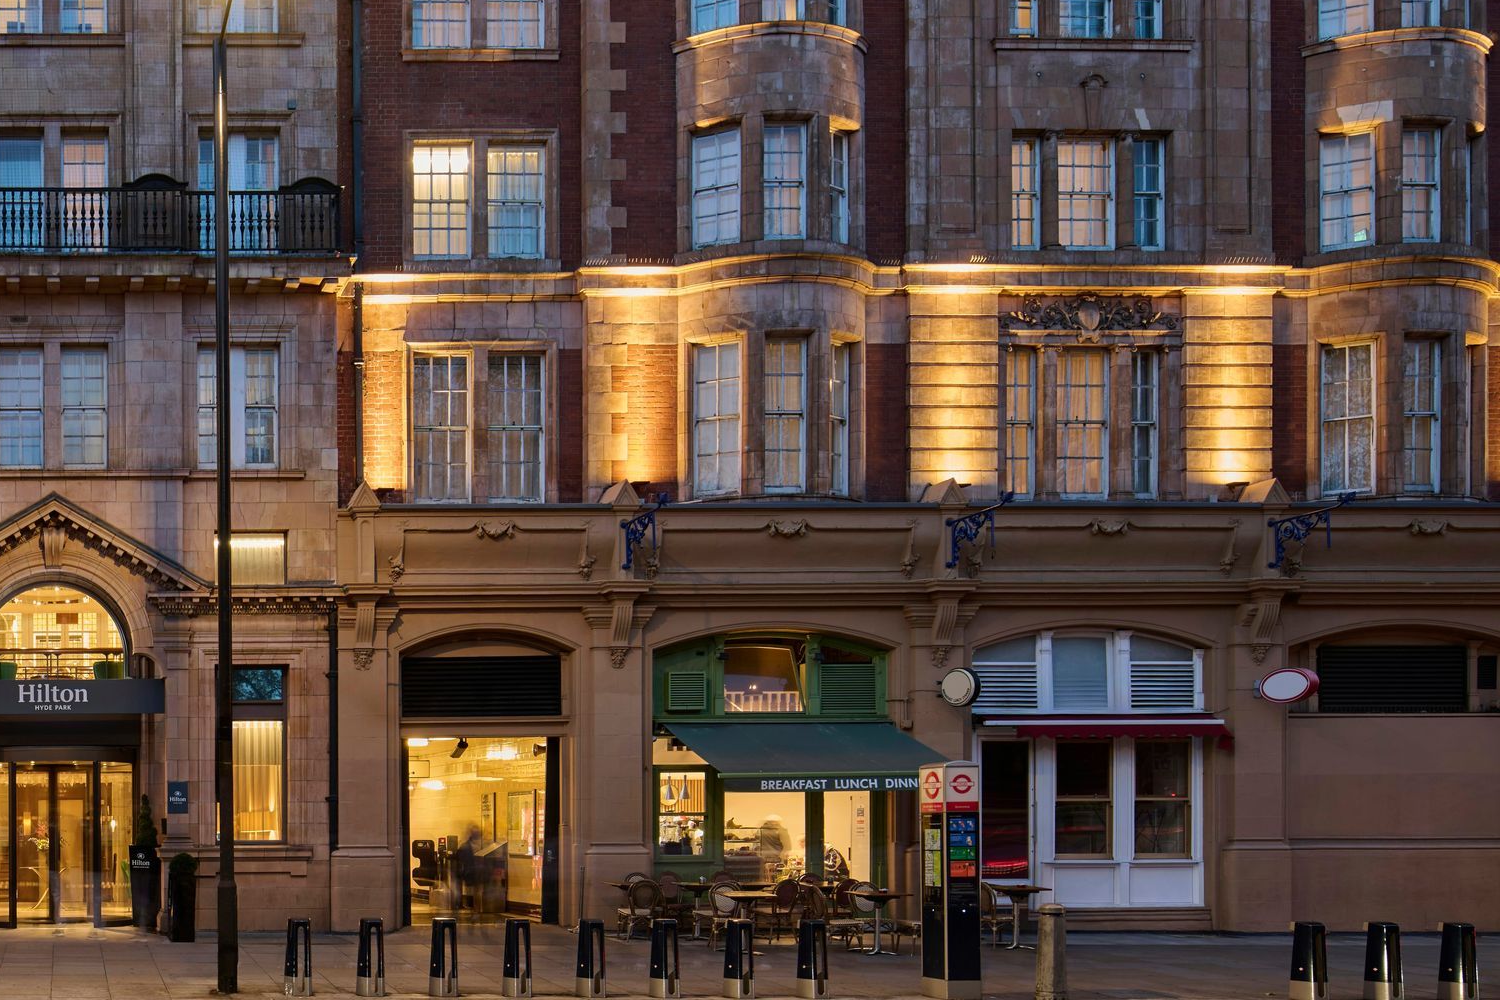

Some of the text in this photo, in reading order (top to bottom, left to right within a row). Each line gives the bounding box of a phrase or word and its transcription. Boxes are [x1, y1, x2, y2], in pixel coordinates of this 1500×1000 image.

[17, 683, 89, 703] Hilton
[760, 779, 828, 791] BREAKFAST
[834, 778, 878, 790] LUNCH
[885, 778, 919, 789] DINN
